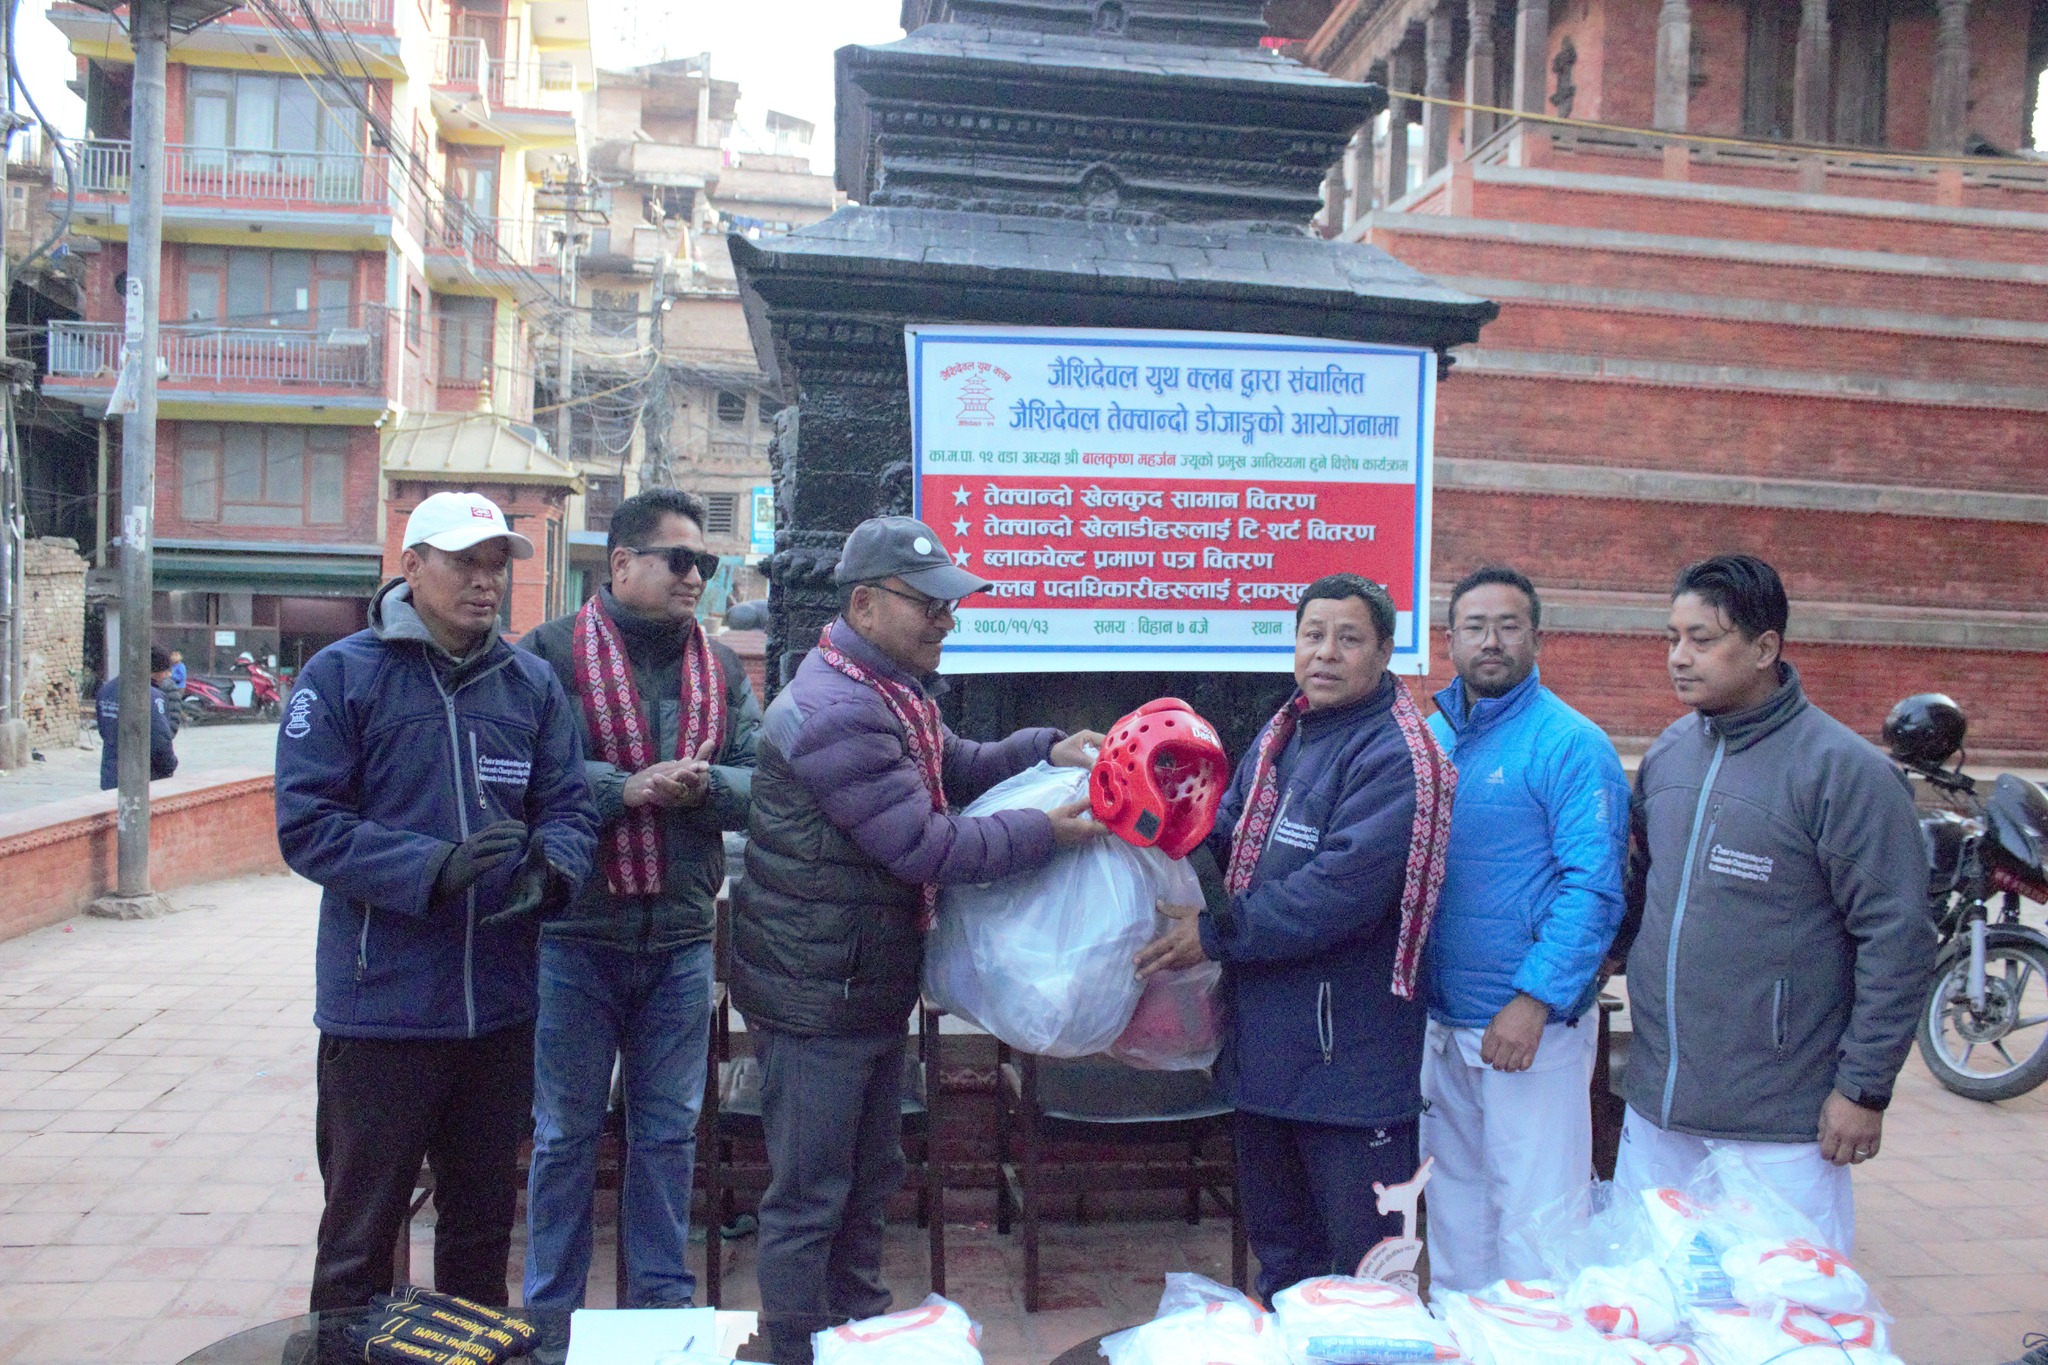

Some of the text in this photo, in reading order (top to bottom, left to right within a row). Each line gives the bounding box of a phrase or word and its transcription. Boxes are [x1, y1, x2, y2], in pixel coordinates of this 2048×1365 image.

[1048, 355, 1366, 398] जैशिदेवल युथ क्लब द्वारा संचालित
[1009, 398, 1101, 431] जैशिदेवल
[1107, 400, 1189, 434] तेक्वान्दो
[1290, 406, 1400, 438] आयोजनामा
[978, 450, 994, 464] १२
[997, 450, 1019, 464] वडा
[1021, 451, 1061, 466] अध्यक्ष
[1064, 448, 1080, 465] श्री
[1082, 452, 1134, 469] बालकृष्ण
[1137, 450, 1177, 467] महर्जन
[1180, 451, 1214, 470] ज्यूको
[1217, 454, 1248, 472] प्रमुख
[1309, 453, 1328, 473] हुने
[1331, 453, 1360, 473] विशेष
[1362, 456, 1410, 472] कार्यक्रम
[983, 483, 1318, 513] तेक्वान्दो खेलकुद सामान वितरण
[983, 513, 1074, 538] तेक्वान्दो
[1238, 517, 1302, 541] टि-शर्ट
[1307, 518, 1377, 542] वितरण
[1093, 550, 1156, 570] प्रमाण
[1162, 551, 1197, 570] पत्र
[1203, 546, 1275, 570] वितरण
[974, 618, 1049, 636] २०८०/११/१३
[1093, 619, 1126, 635] समय
[1176, 620, 1186, 634] ७
[1189, 616, 1209, 635] बजे
[1251, 620, 1283, 636] स्थान
[412, 1326, 447, 1343] THAMI
[484, 1329, 513, 1348] UNIK
